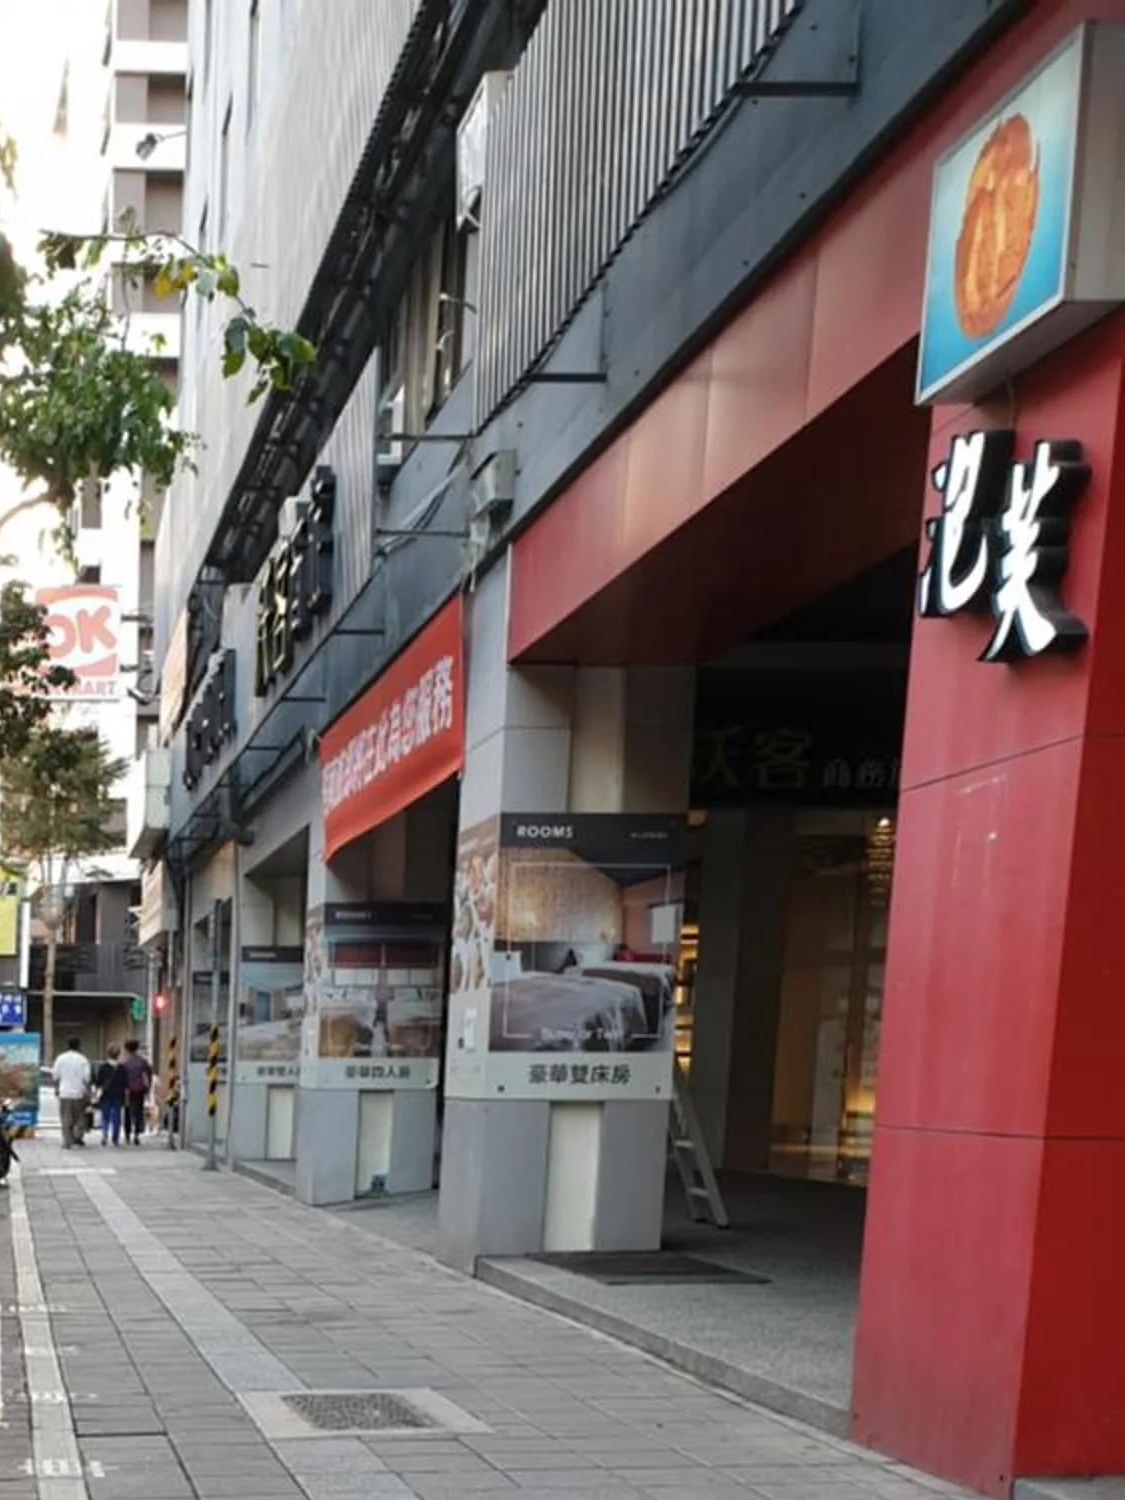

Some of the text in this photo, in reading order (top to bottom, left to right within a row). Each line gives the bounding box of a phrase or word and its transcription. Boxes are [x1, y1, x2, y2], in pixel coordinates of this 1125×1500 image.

[40, 604, 118, 660] OK
[516, 825, 574, 839] ROOMS
[527, 1063, 633, 1086] 豪華雙床房
